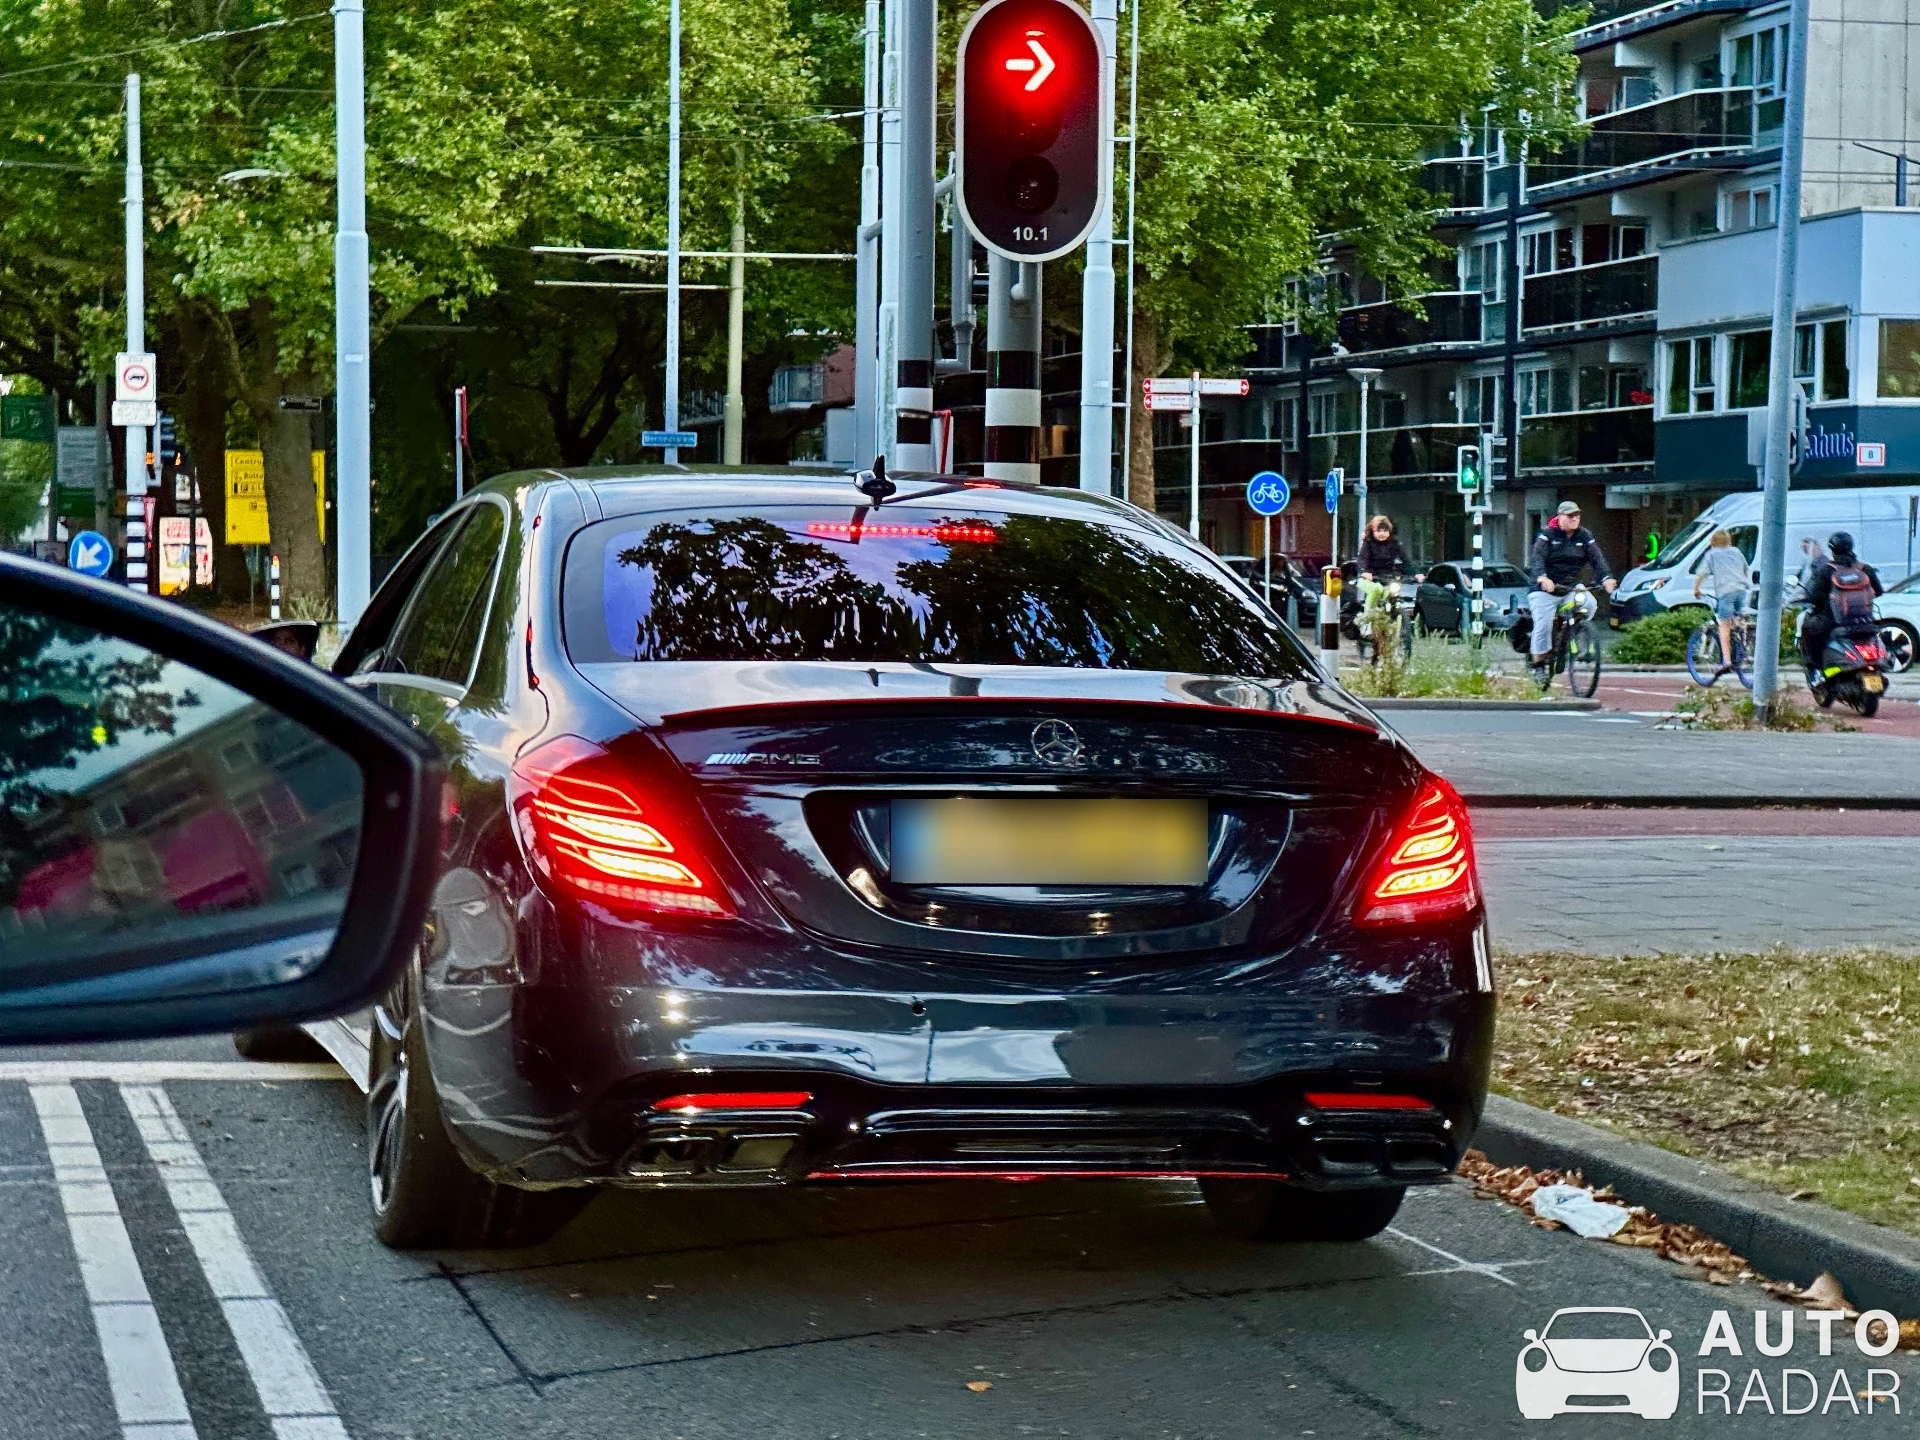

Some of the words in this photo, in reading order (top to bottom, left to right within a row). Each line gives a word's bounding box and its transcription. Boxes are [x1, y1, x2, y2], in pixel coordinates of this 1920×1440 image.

[1013, 226, 1048, 241] 10.1
[1805, 423, 1855, 458] ahuis
[744, 753, 820, 765] AMG
